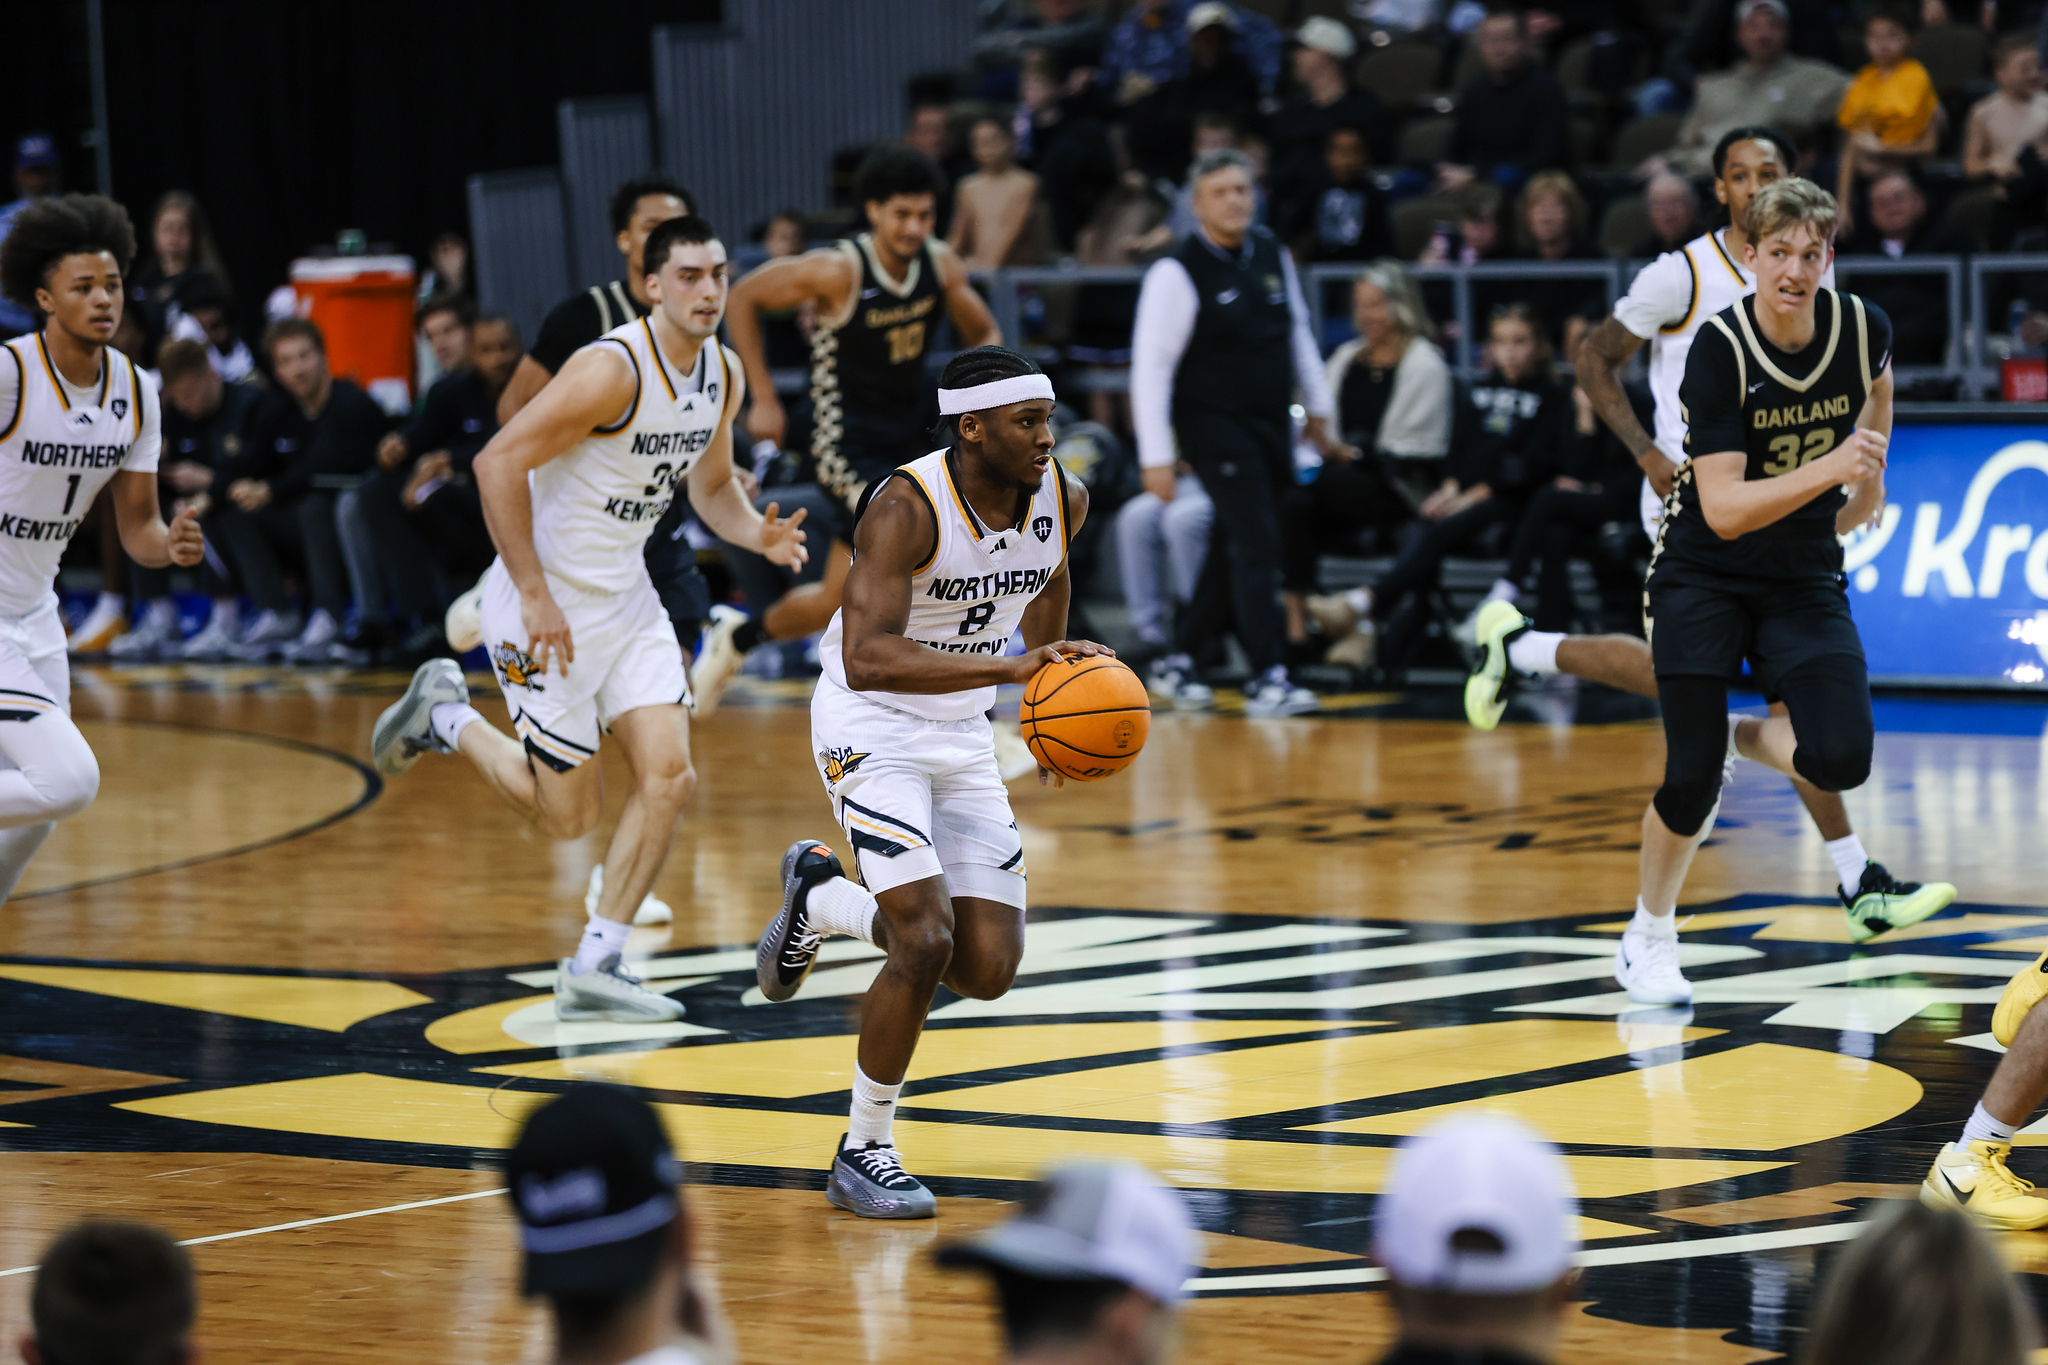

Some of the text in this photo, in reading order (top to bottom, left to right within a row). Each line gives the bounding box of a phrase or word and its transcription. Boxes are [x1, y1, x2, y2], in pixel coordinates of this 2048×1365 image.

[1753, 394, 1850, 430] OAKLAND
[1763, 427, 1836, 477] 32
[62, 473, 82, 516] 1
[926, 566, 1052, 601] NORTHERN
